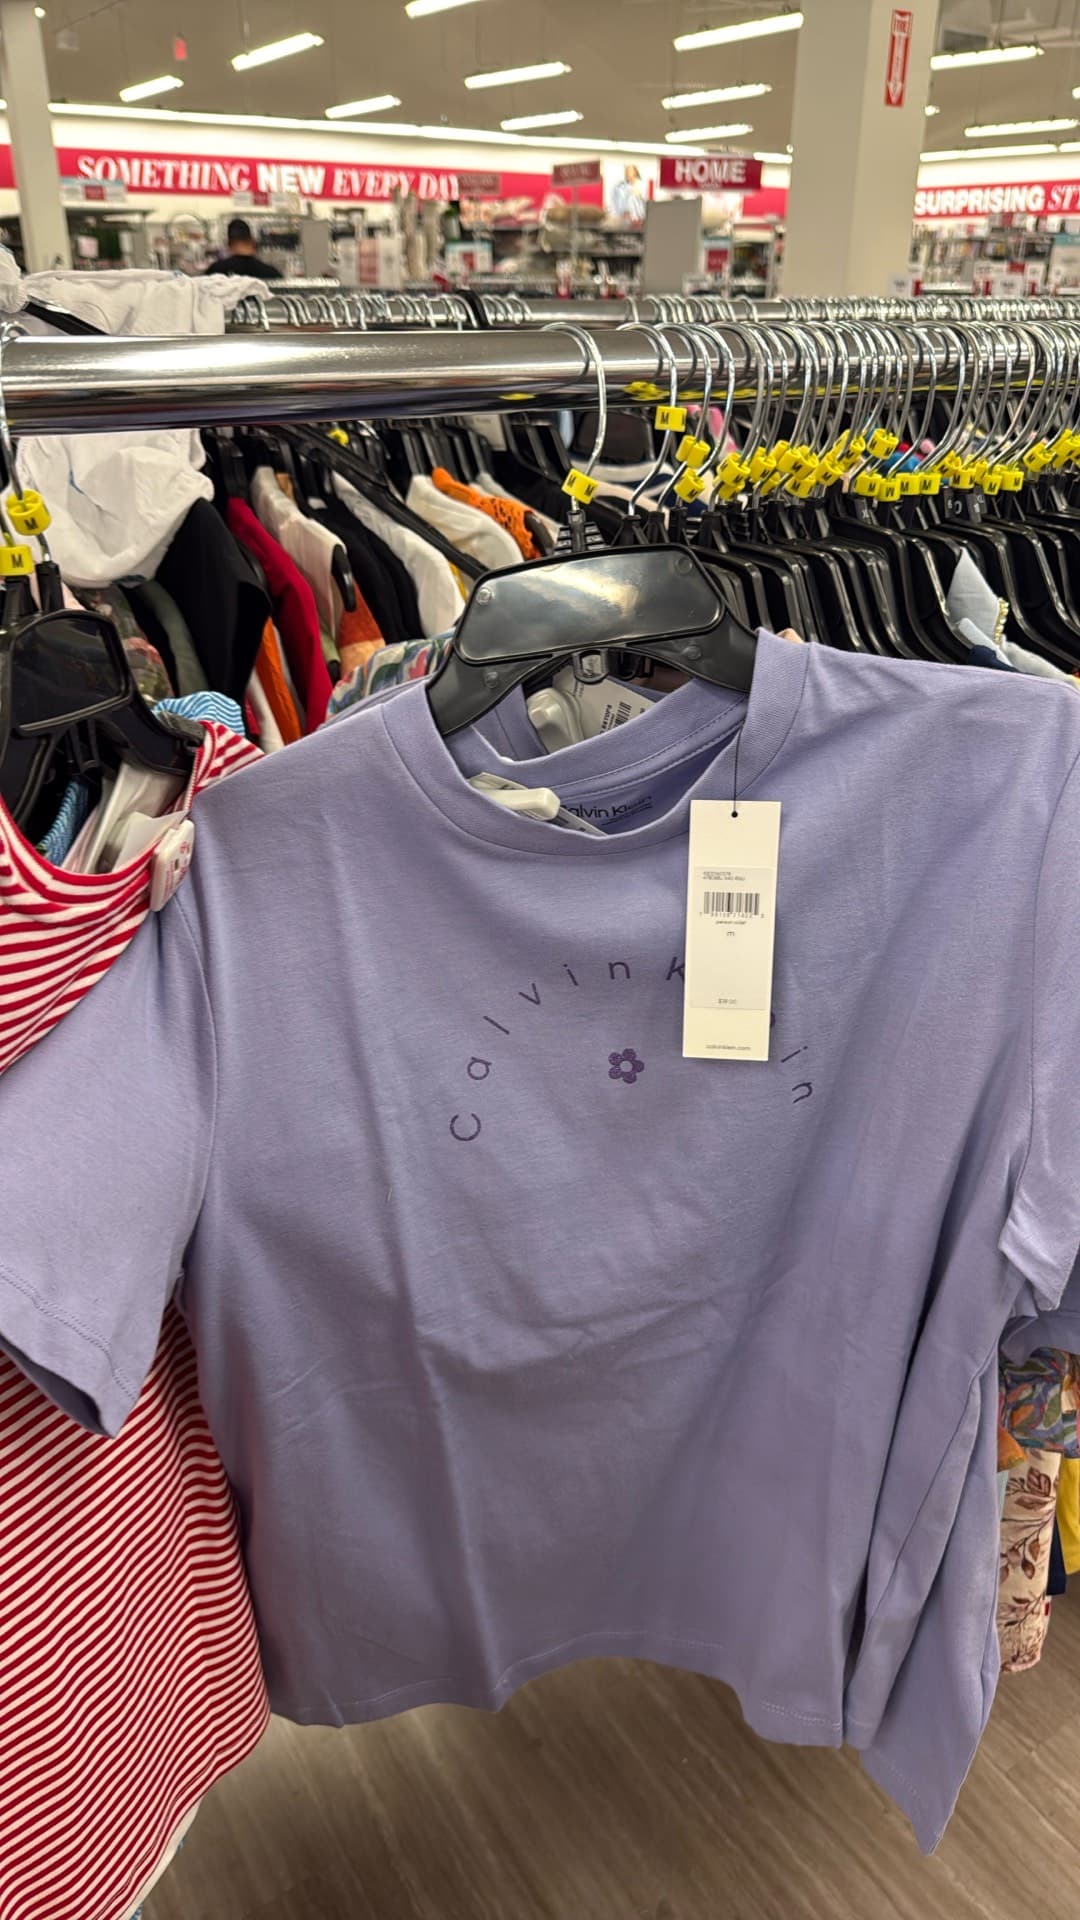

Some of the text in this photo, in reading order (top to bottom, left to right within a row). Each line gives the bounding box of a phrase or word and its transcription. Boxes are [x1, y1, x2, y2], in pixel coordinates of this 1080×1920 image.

[77, 155, 250, 192] SOMETHING
[256, 163, 325, 195] NEW
[332, 168, 415, 199] EVERY
[675, 159, 746, 183] HOME
[914, 185, 1046, 216] SURPRISING
[660, 412, 669, 424] M
[901, 481, 909, 491] M
[923, 479, 932, 490] M
[24, 517, 39, 531] M
[11, 554, 24, 568] M
[449, 961, 631, 1142] Calvin
